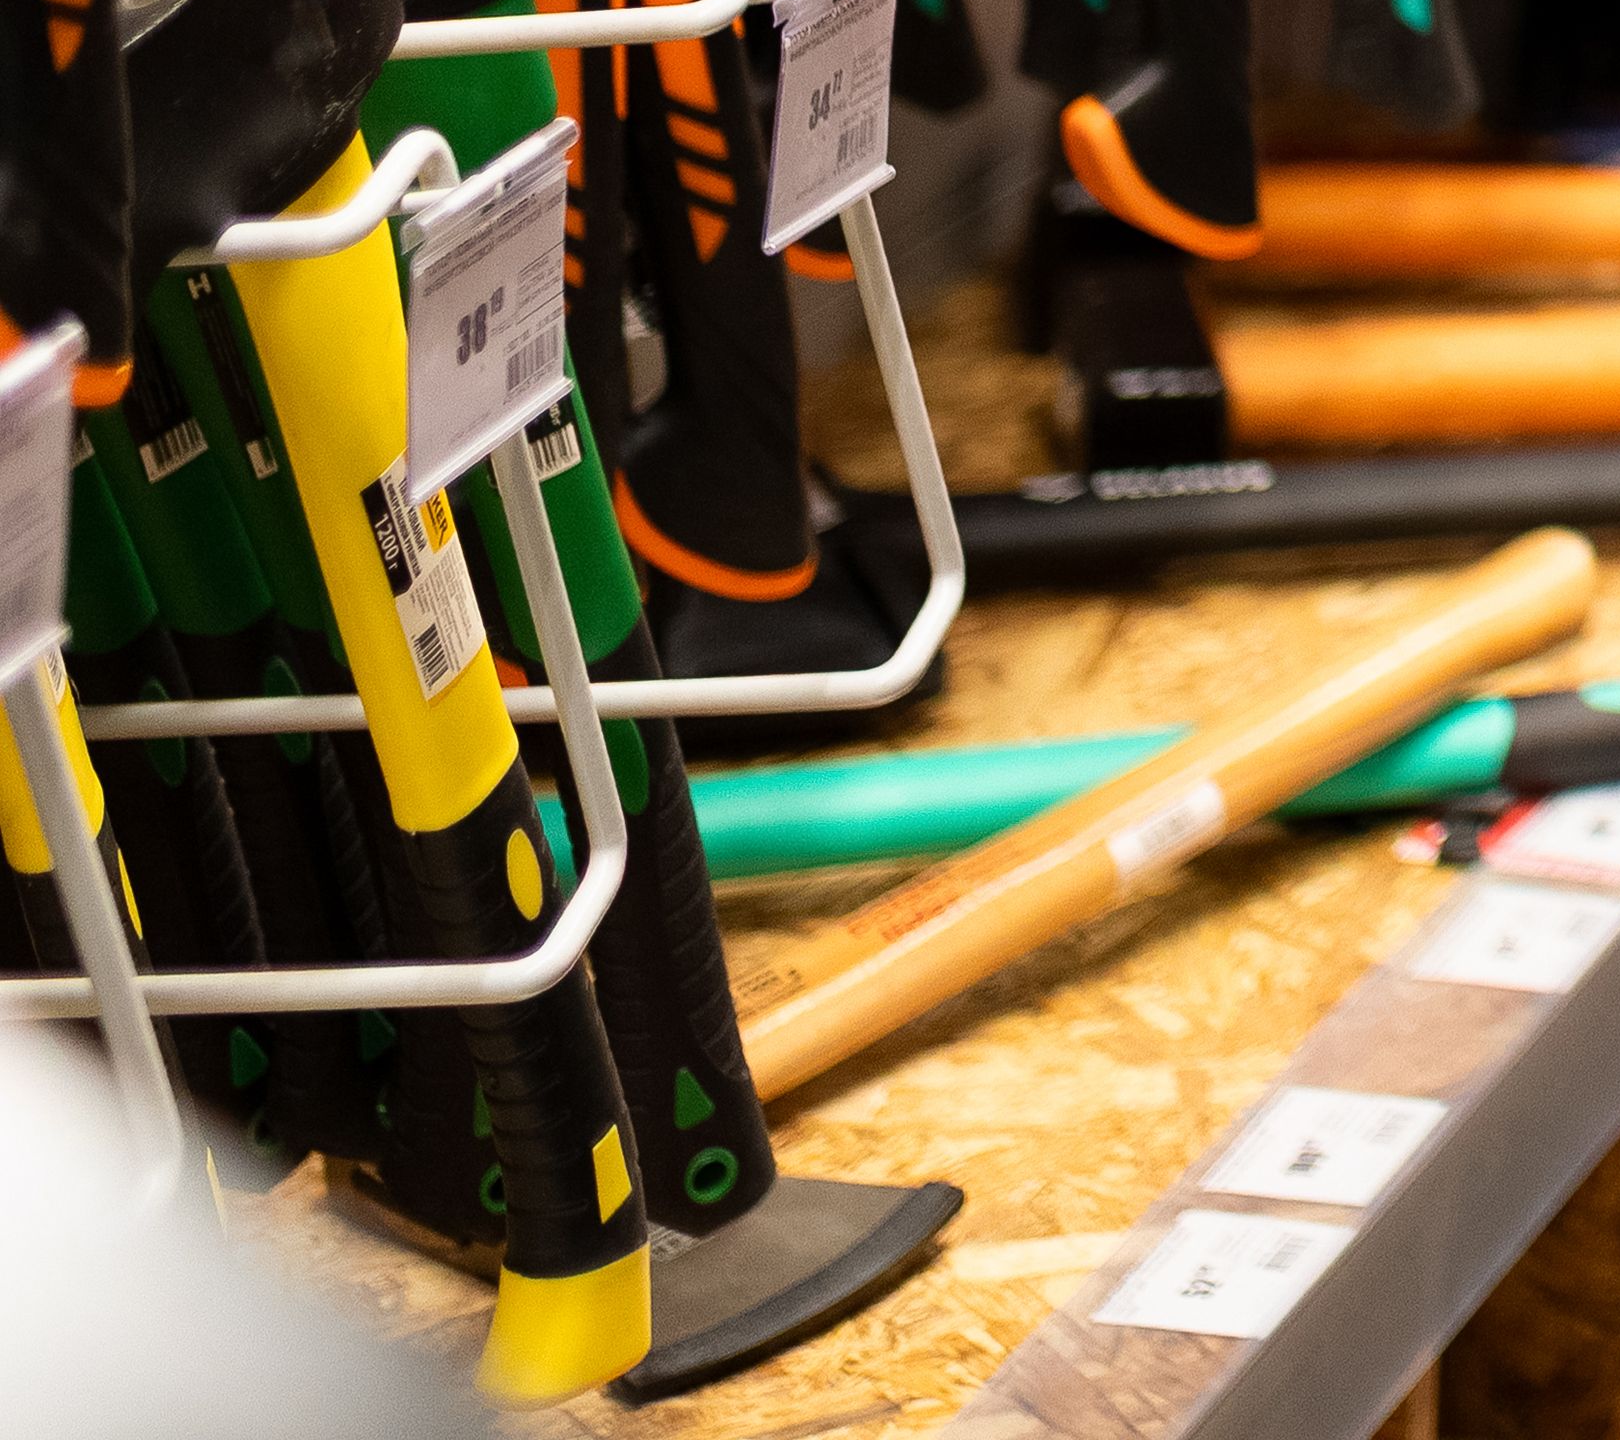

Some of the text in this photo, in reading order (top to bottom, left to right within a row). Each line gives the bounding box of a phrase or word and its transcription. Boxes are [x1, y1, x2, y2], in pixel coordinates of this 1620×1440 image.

[808, 82, 831, 131] 34
[456, 302, 488, 366] 38
[374, 513, 400, 570] 1200 г
[406, 507, 427, 552] КОВАНЫЙ
